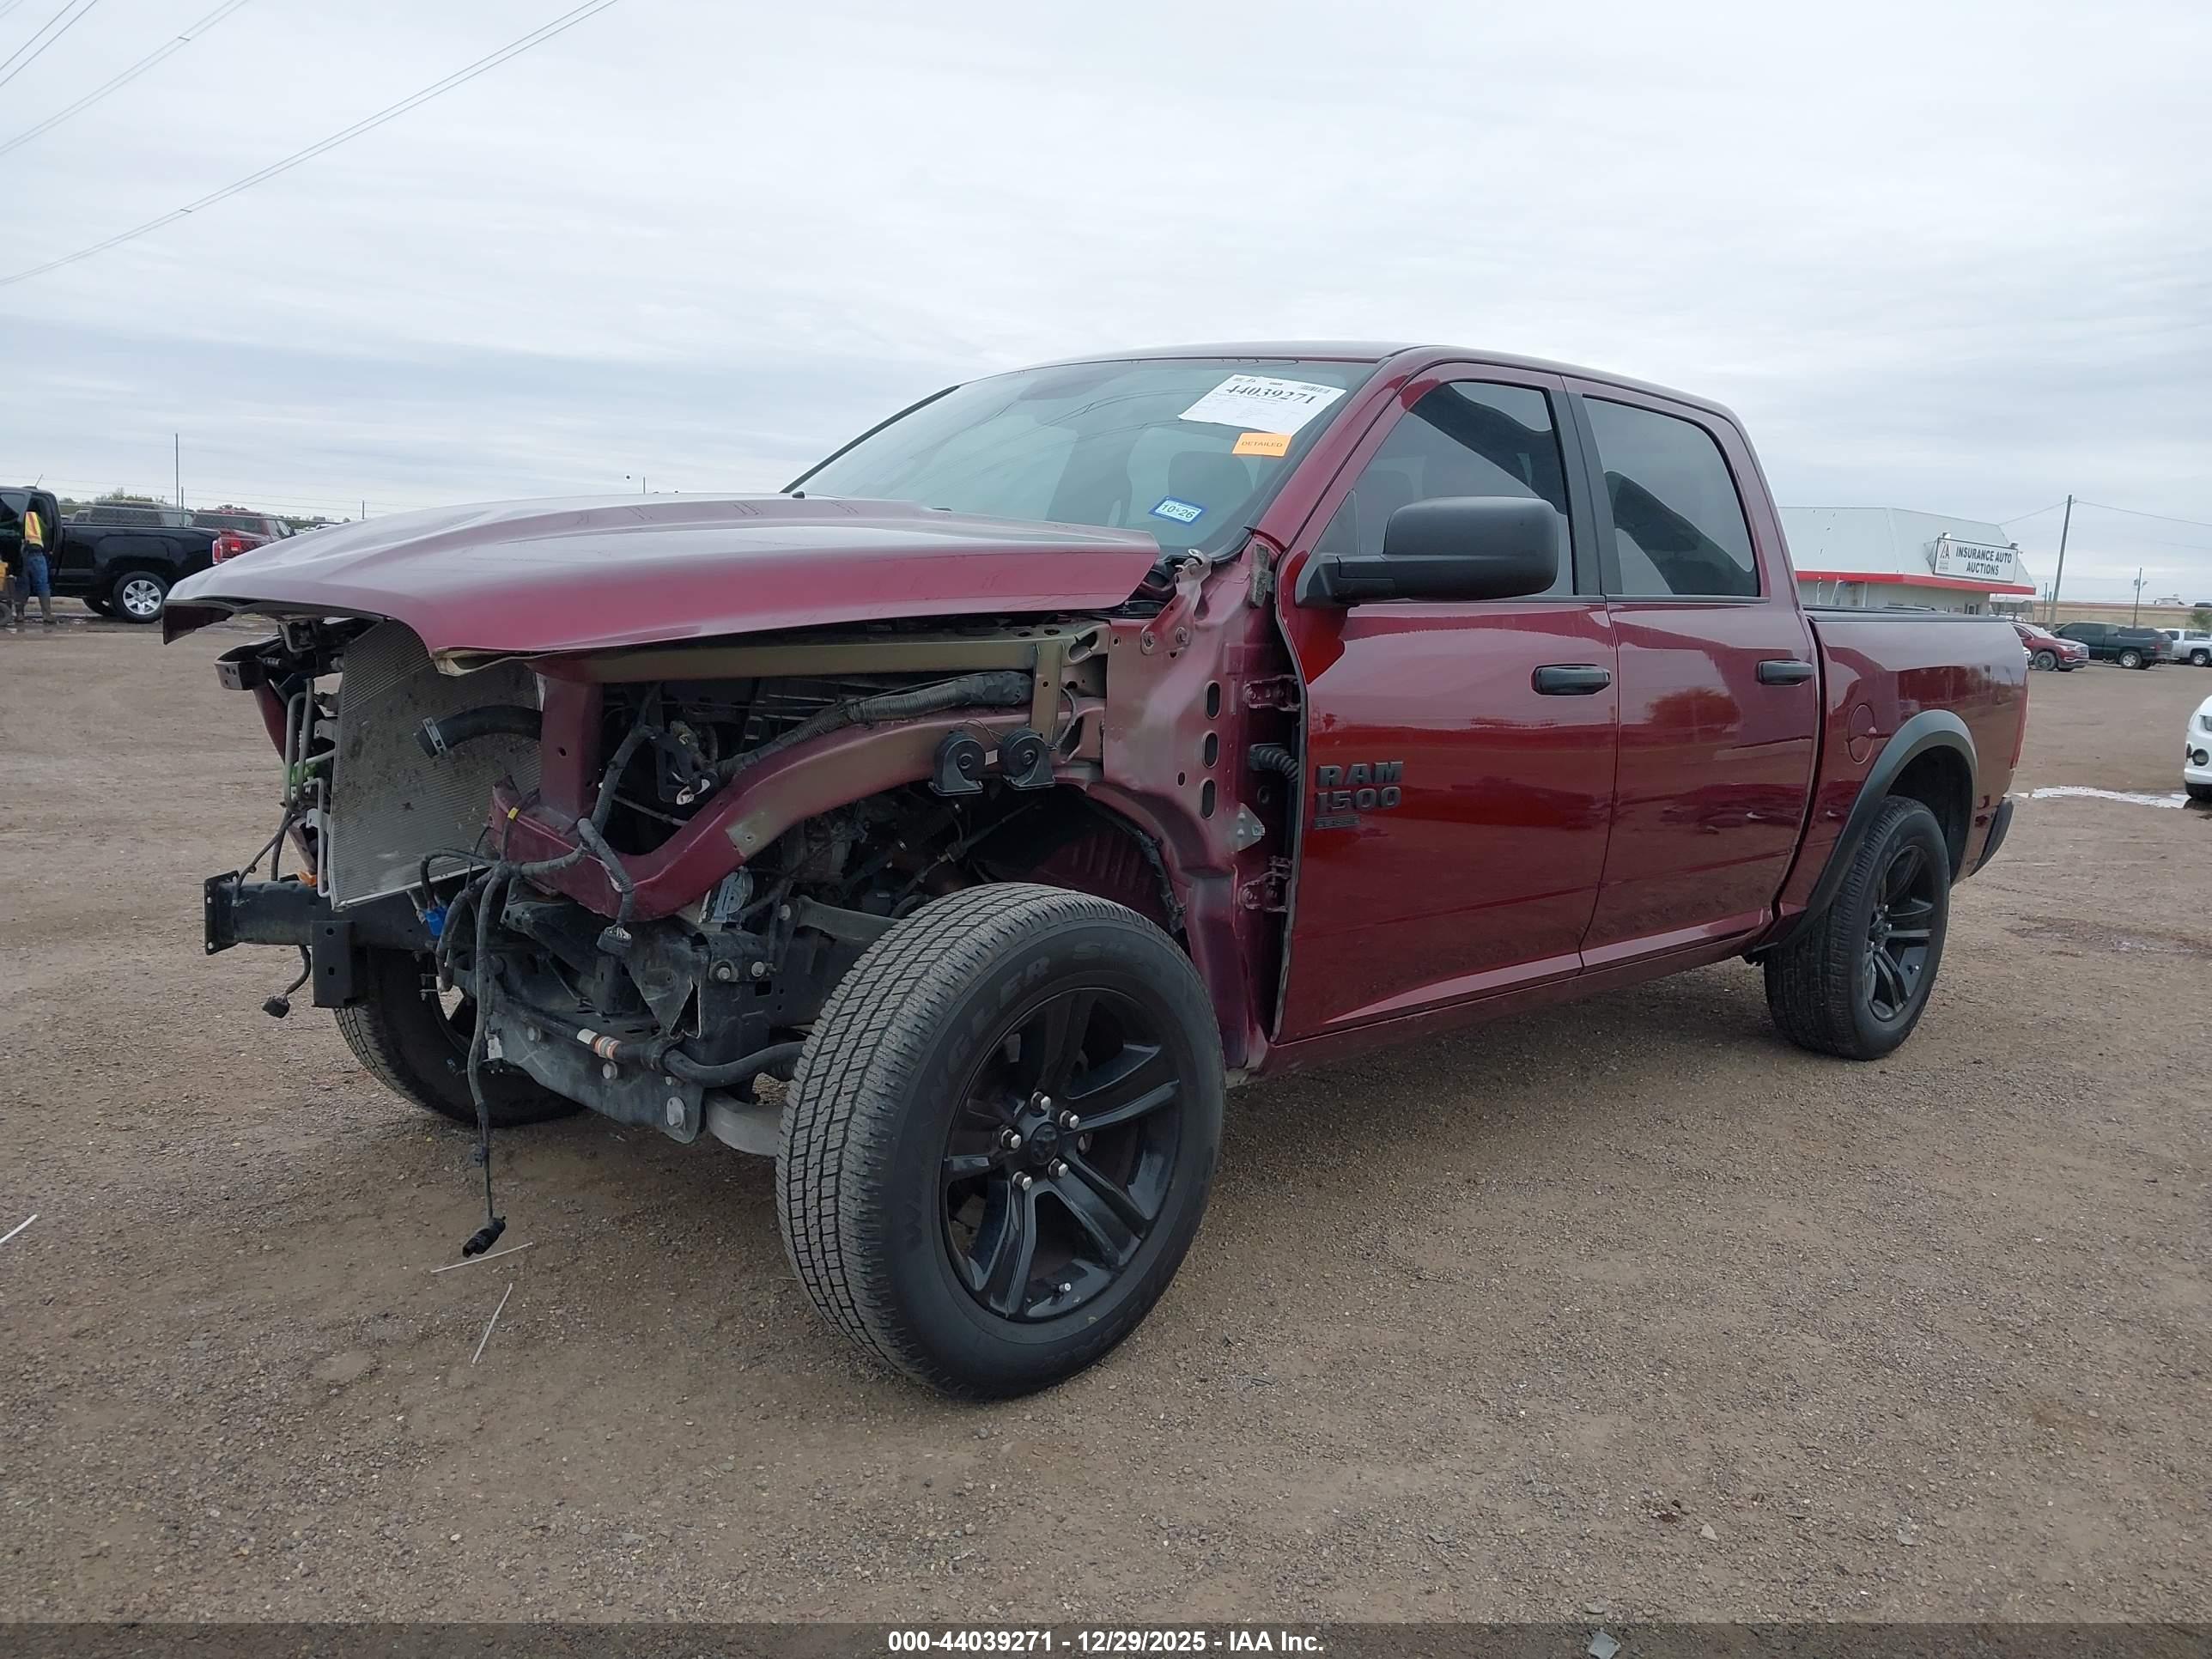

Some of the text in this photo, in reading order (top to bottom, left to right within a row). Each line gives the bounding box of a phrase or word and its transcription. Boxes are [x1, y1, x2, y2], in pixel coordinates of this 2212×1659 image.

[1226, 385, 1316, 404] 44039271
[1162, 503, 1194, 519] 10 26
[1956, 546, 1994, 562] INSURANCE
[1996, 552, 2012, 563] AUTO
[1966, 562, 1999, 576] AUCTIONS
[1317, 761, 1403, 786] RAM
[1316, 787, 1401, 812] 1500
